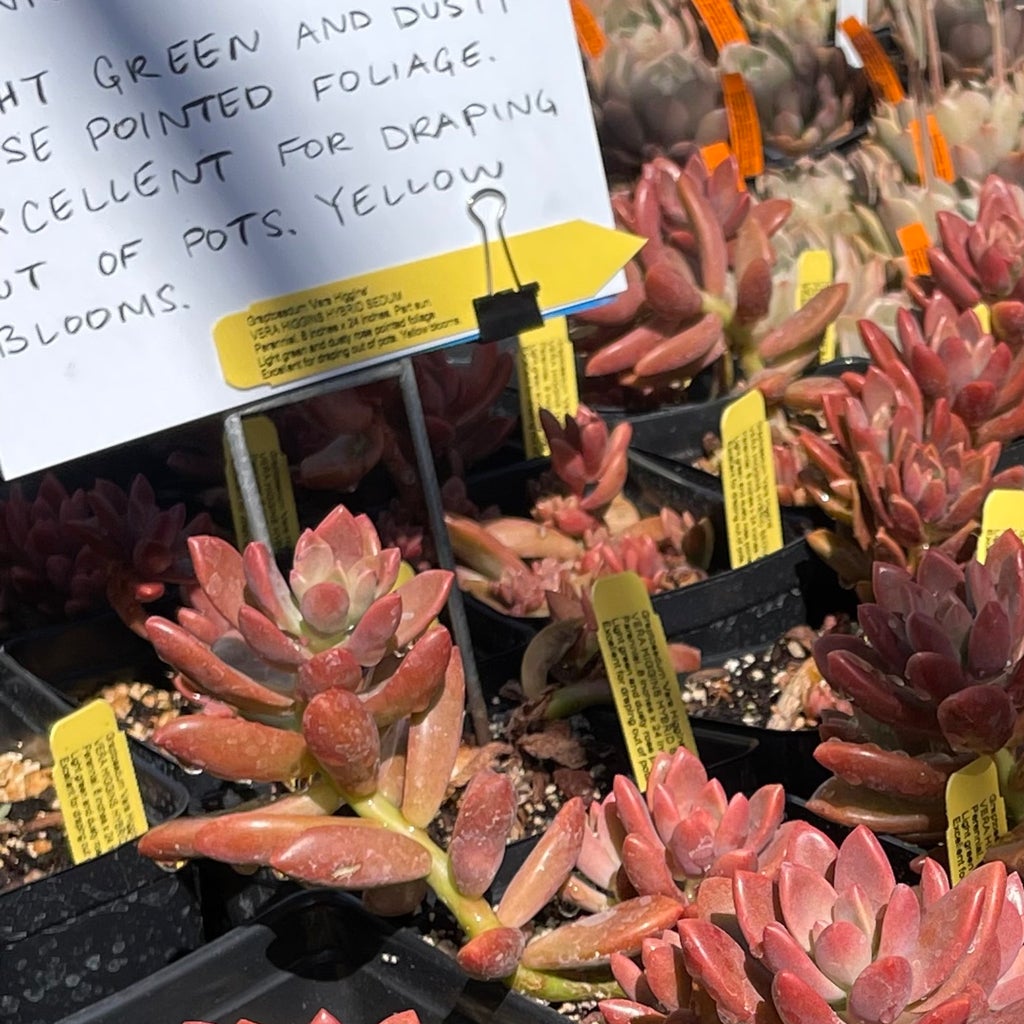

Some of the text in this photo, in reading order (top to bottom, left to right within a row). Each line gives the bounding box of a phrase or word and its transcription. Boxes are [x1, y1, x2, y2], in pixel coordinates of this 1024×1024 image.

[93, 30, 260, 95] GREEN
[297, 10, 372, 50] AND
[1, 41, 496, 164] SE POINTED FOLIAGE.
[278, 132, 353, 167] FOR
[380, 89, 558, 150] DRAPING
[99, 238, 143, 276] OF
[183, 208, 297, 258] POTS.
[314, 161, 503, 226] YELLOW
[0, 283, 190, 358] BLOOMS.
[631, 612, 674, 744] VERA HIGGINS HYBRID
[961, 810, 973, 870] Light green
[980, 799, 989, 834] VERA
[958, 866, 966, 879] fo
